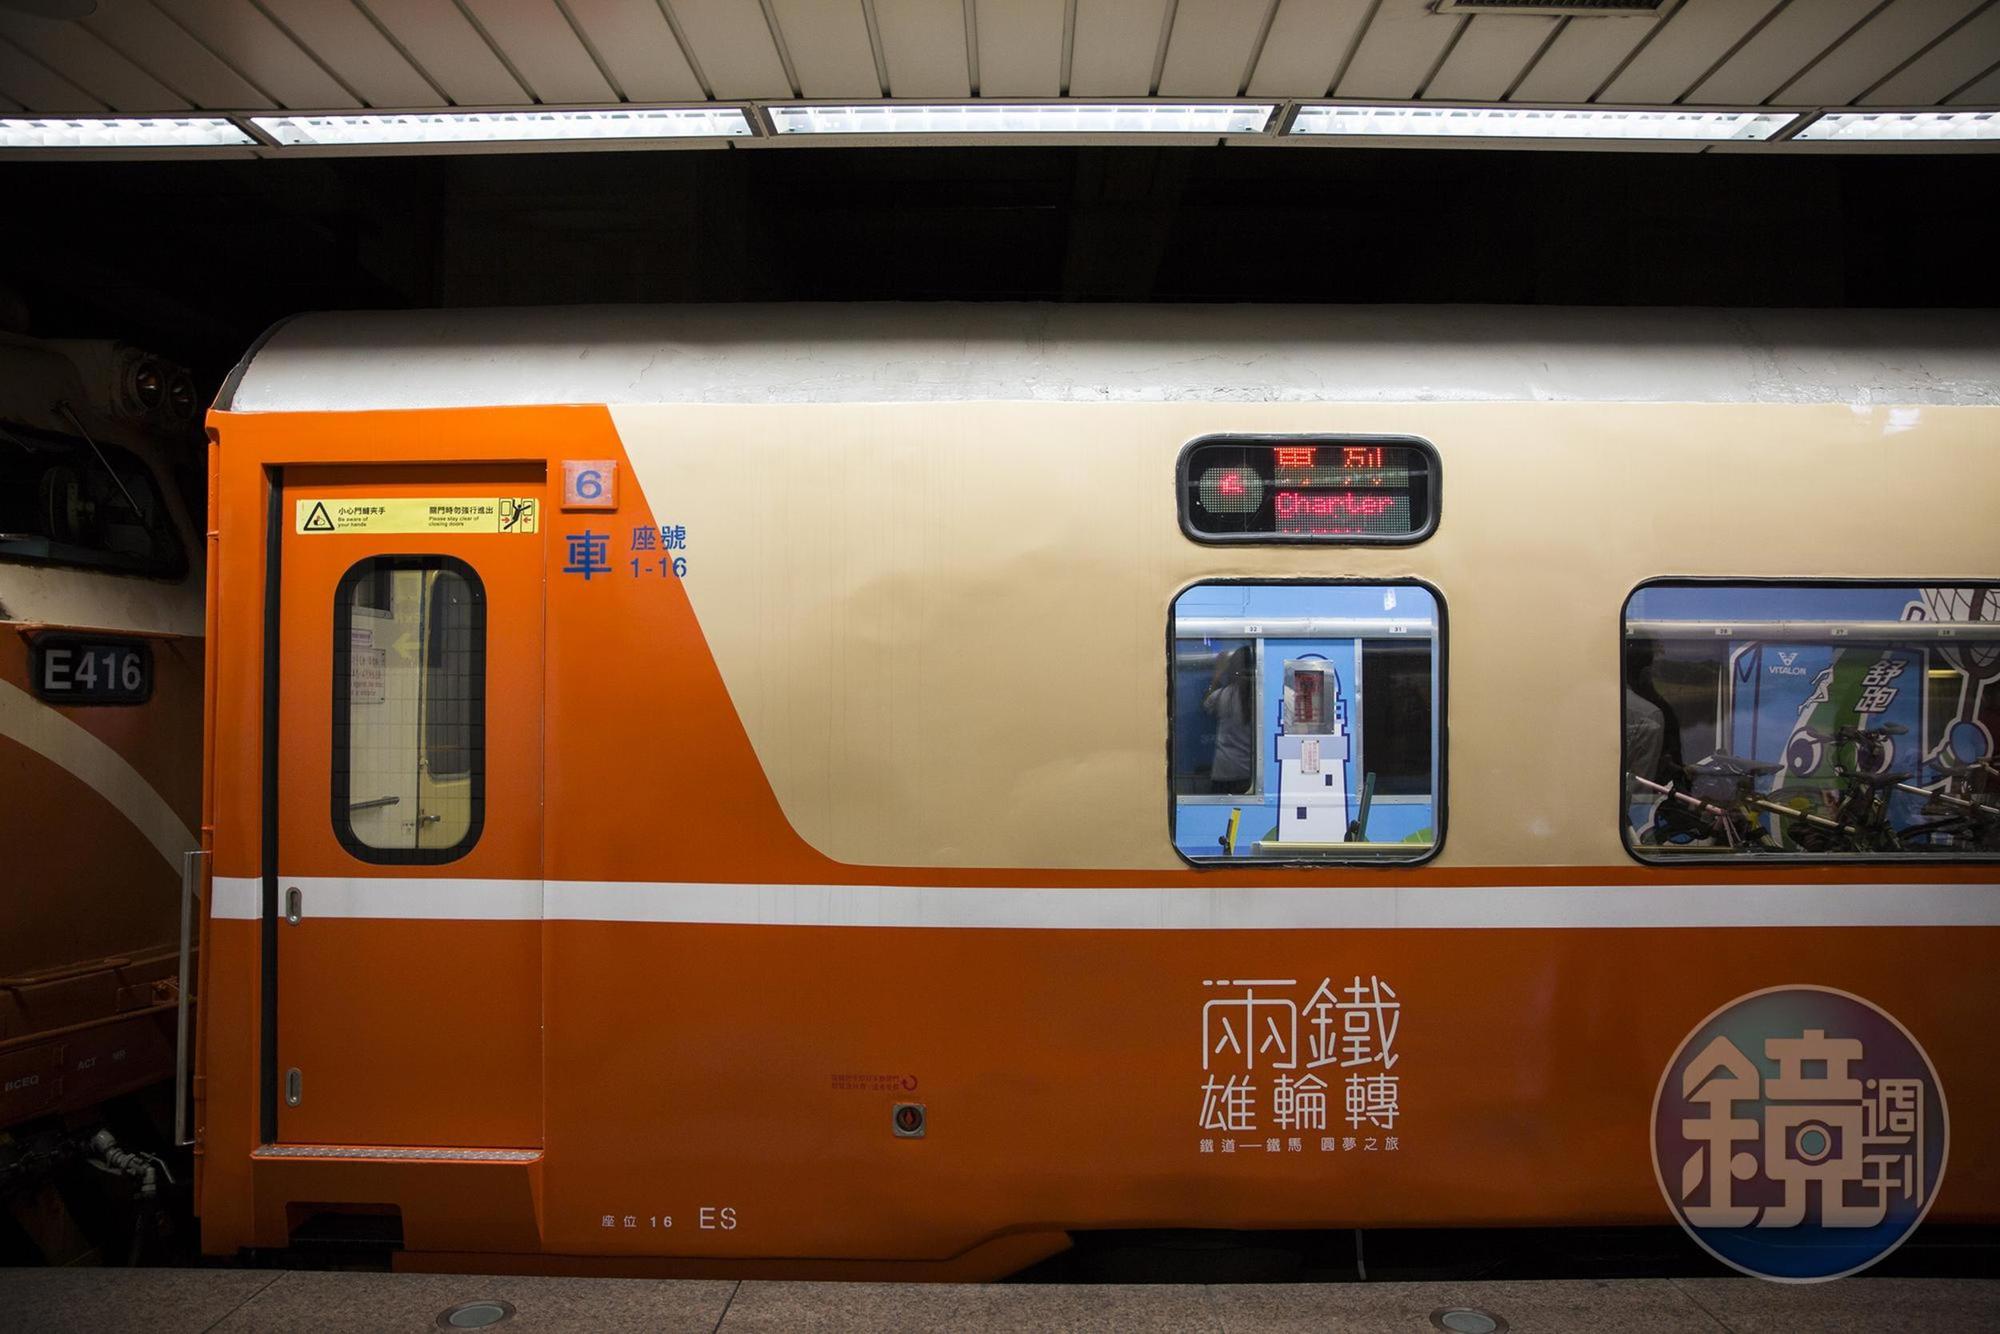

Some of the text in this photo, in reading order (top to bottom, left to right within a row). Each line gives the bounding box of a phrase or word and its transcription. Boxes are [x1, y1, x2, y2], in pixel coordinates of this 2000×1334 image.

[575, 470, 602, 499] 6
[429, 506, 494, 515] 關門時勿強行進出
[1275, 492, 1396, 516] Charter
[630, 525, 687, 551] 座號
[563, 530, 612, 580] 車
[630, 557, 687, 578] 1-16
[45, 649, 141, 690] E416
[1768, 666, 1808, 676] VITALON
[1854, 659, 1908, 713] 舒跑
[1199, 1072, 1400, 1131] 雄輪轉
[1321, 1136, 1400, 1152] 圓夢之旅
[602, 1206, 738, 1230] 座位 16 ES
